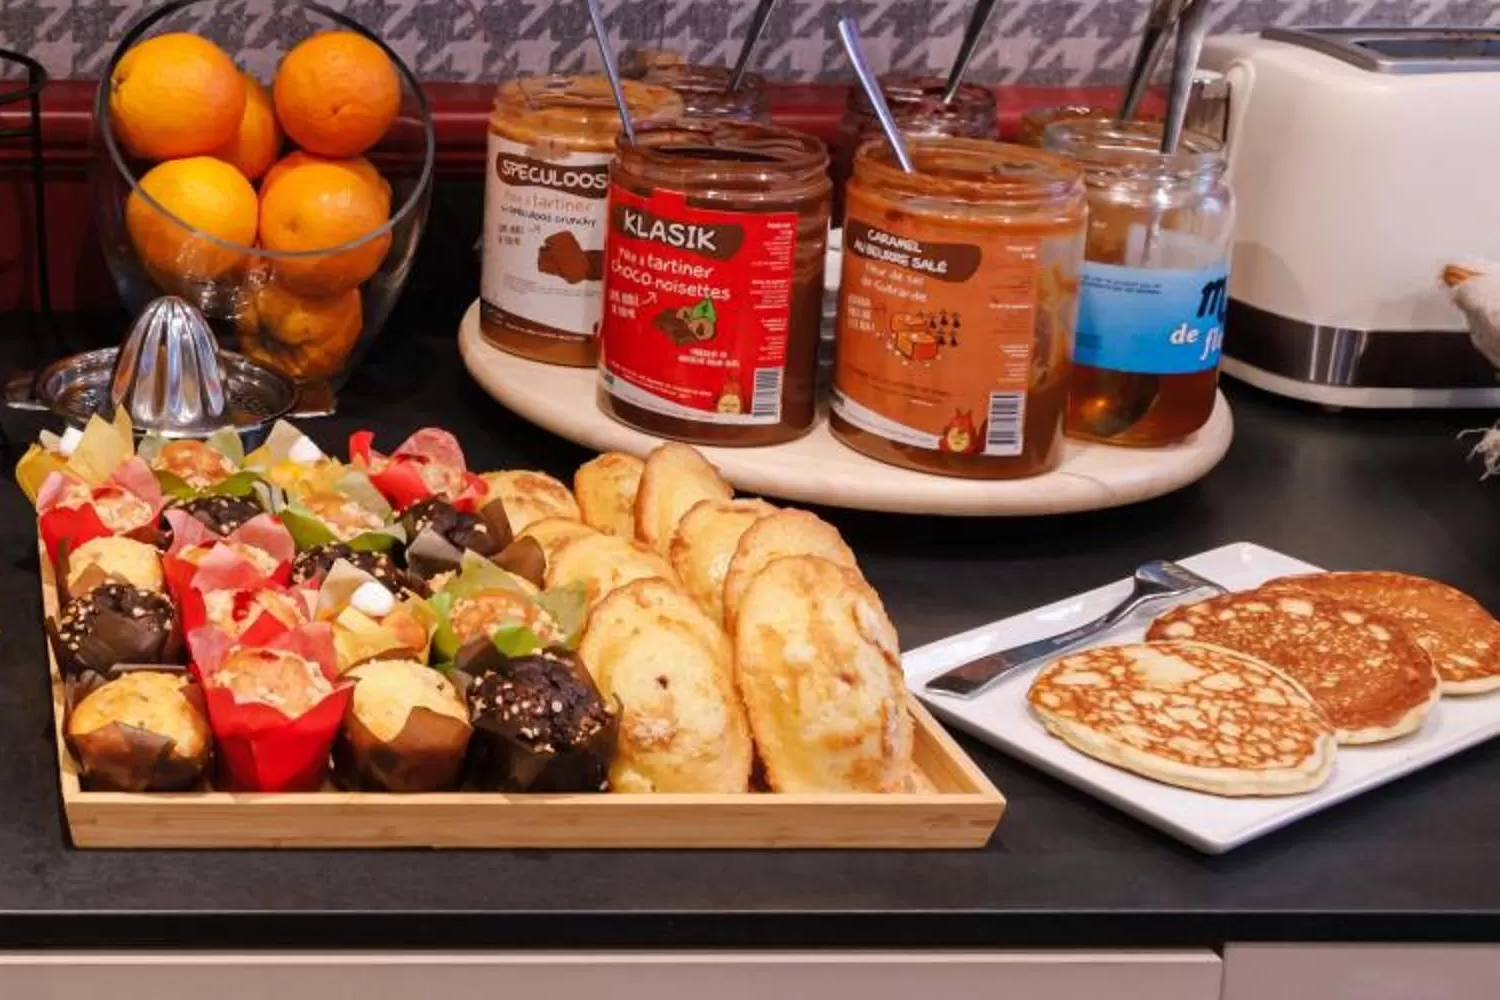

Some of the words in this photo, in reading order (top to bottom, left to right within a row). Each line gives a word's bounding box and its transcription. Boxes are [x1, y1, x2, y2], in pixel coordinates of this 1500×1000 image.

[502, 159, 608, 189] SPECULOOS
[623, 208, 716, 251] KLASIK
[648, 252, 715, 279] tartiner
[1170, 322, 1199, 345] de
